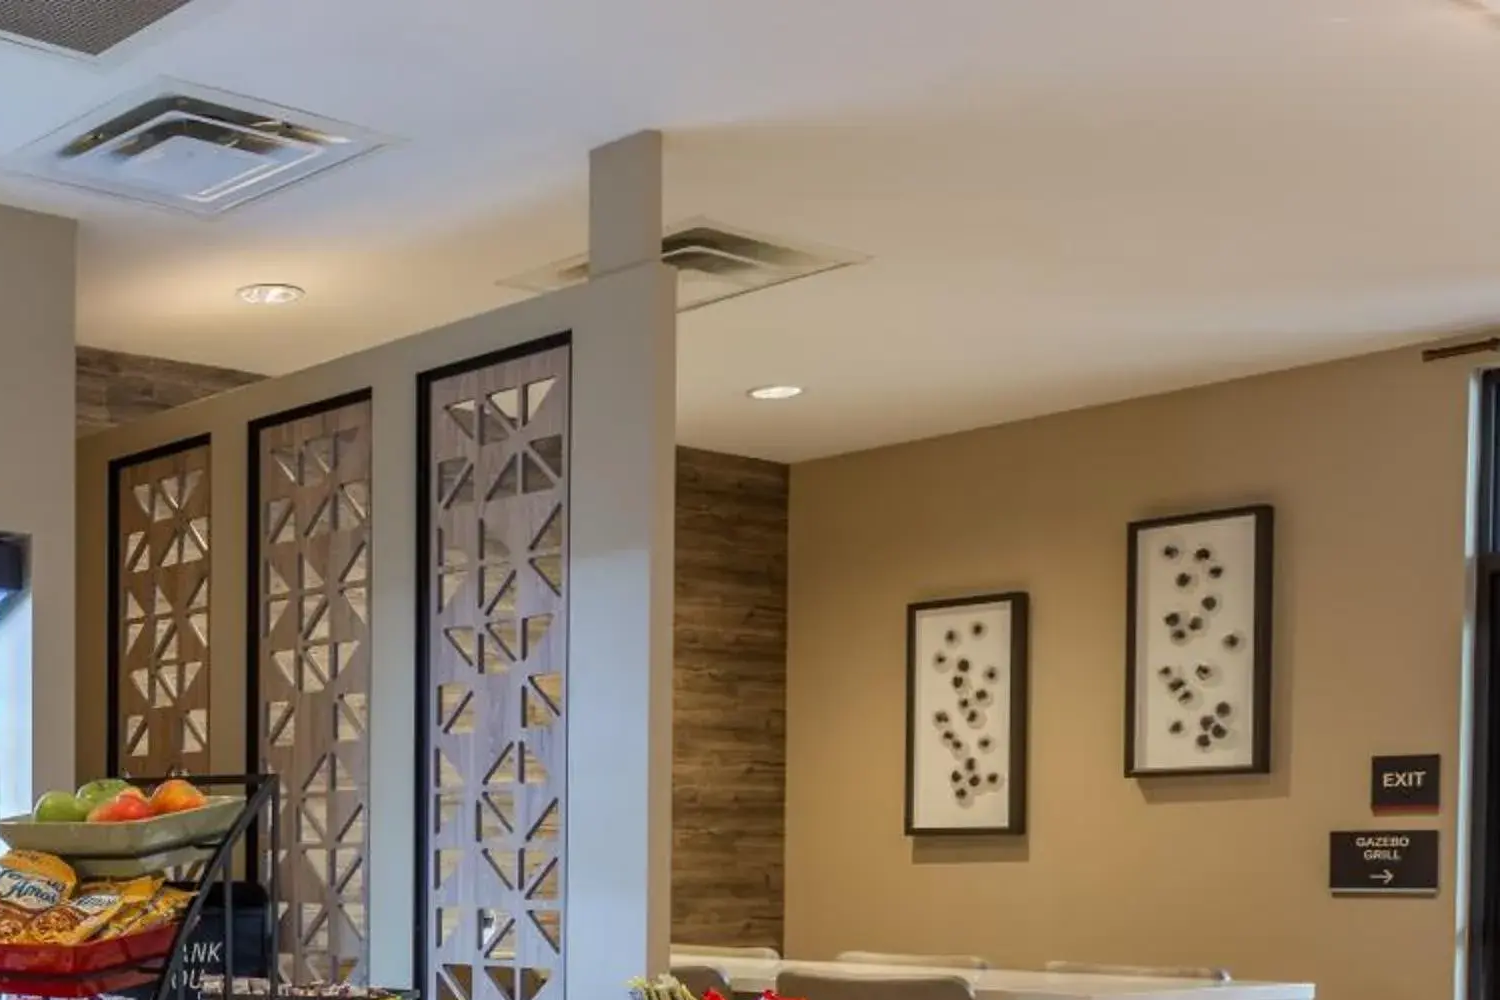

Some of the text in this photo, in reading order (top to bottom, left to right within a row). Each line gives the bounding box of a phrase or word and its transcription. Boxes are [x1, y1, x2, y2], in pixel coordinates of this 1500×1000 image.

[1382, 771, 1427, 788] EXIT
[1355, 836, 1410, 848] GAZEBO
[1363, 849, 1402, 861] GRILL
